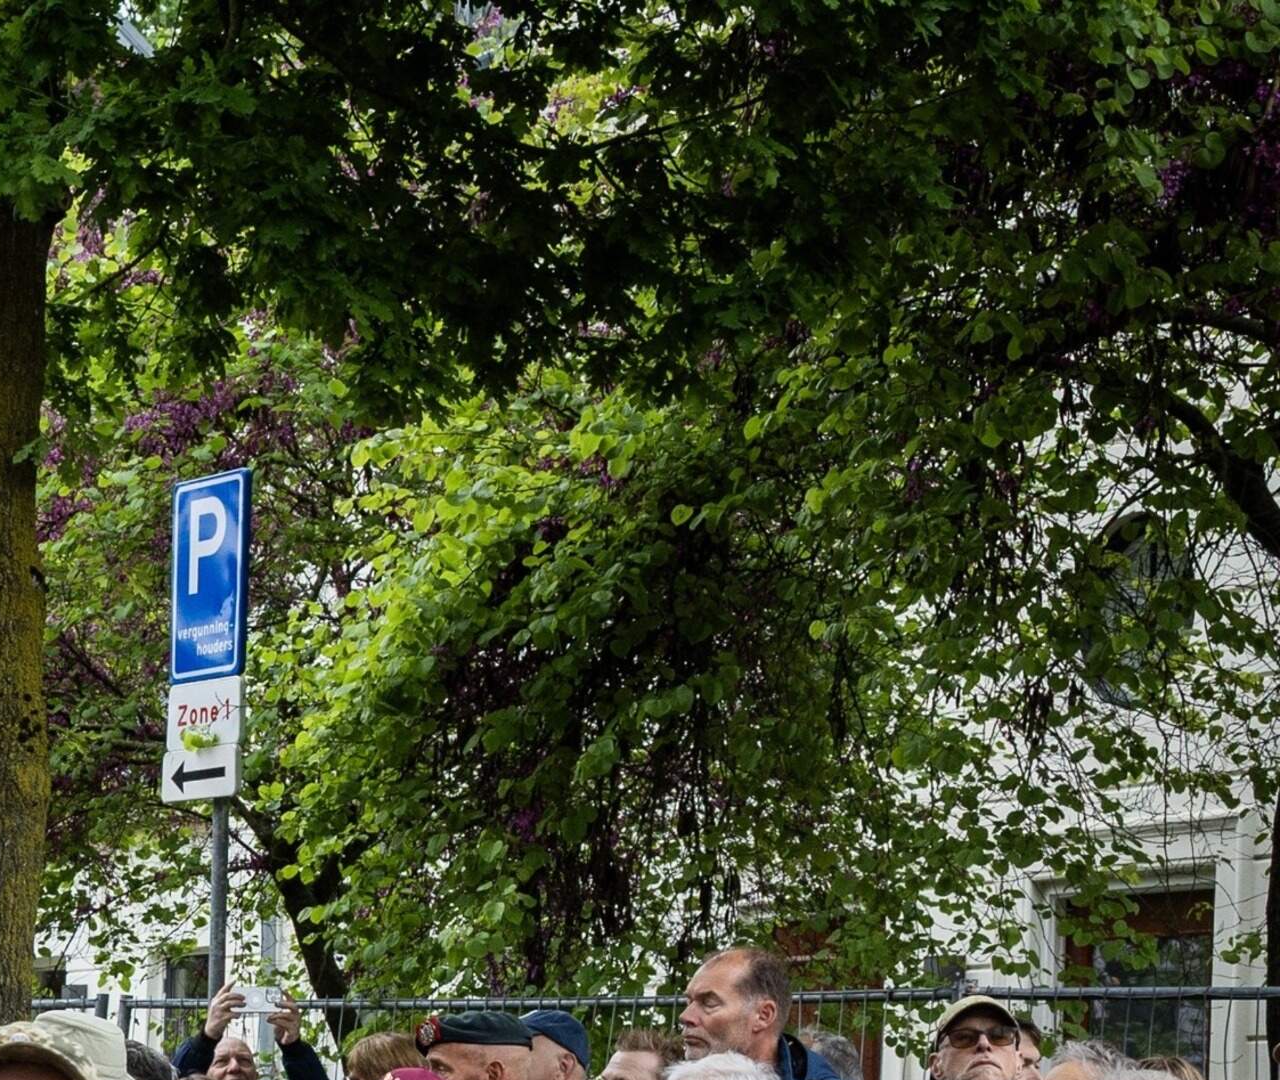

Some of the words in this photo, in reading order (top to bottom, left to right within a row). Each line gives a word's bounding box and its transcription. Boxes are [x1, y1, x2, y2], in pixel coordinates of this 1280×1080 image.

[188, 495, 228, 595] P
[177, 620, 234, 642] vergunning-
[196, 639, 233, 657] houders
[177, 704, 219, 727] Zone
